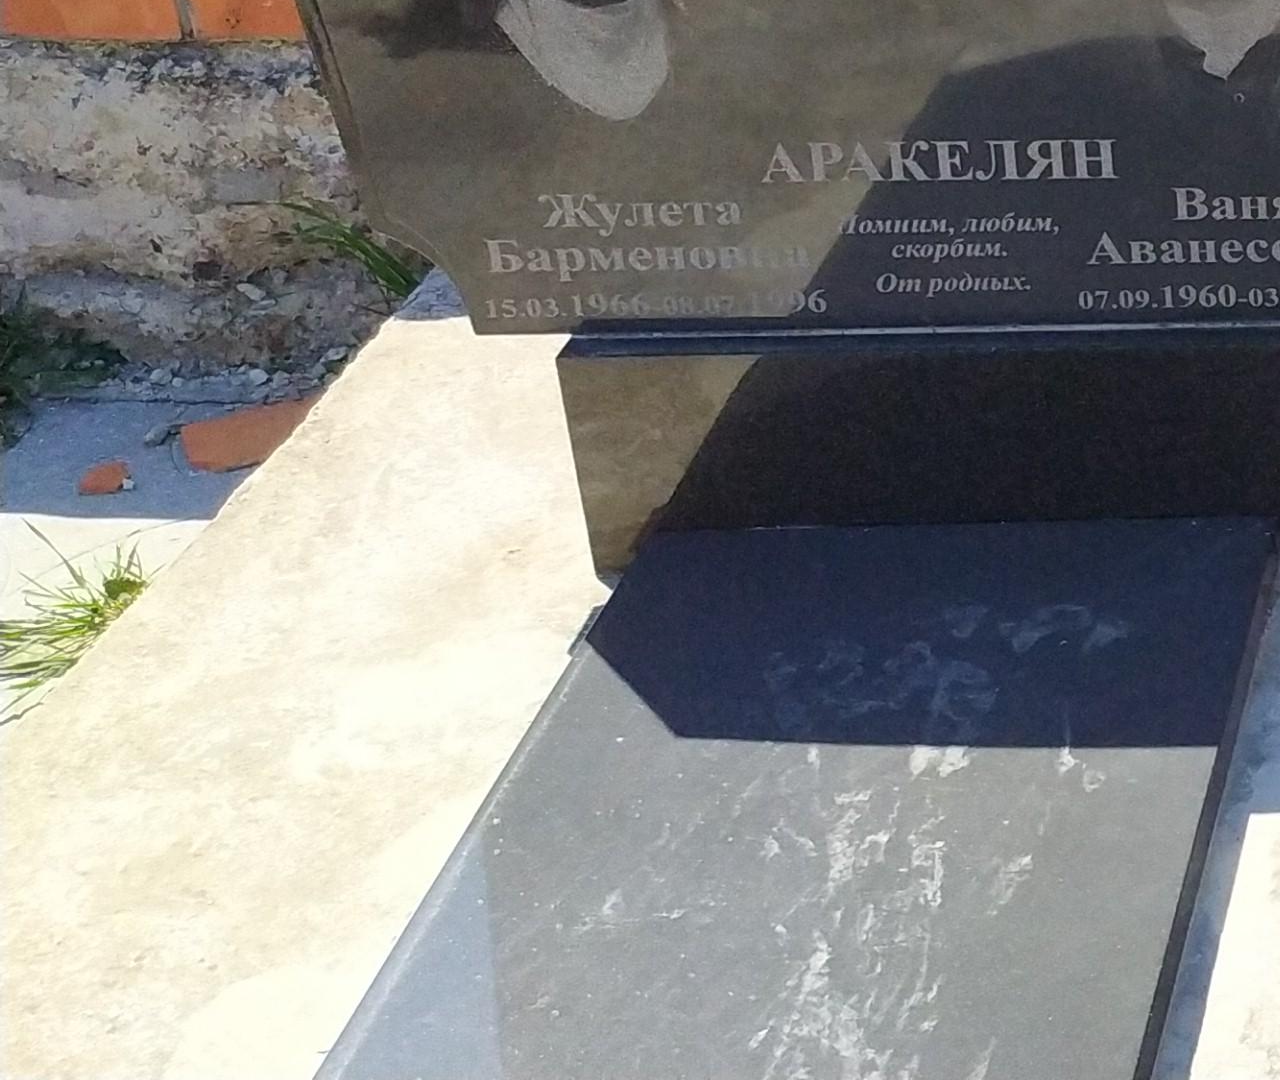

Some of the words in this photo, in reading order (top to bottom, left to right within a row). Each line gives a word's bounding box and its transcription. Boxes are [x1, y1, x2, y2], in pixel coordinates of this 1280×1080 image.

[761, 139, 1119, 182] АРАКЕЛЯН
[538, 193, 743, 236] Жулета
[961, 212, 1061, 234] любим,
[891, 238, 1008, 263] скорбим.
[875, 272, 921, 294] От
[926, 271, 1032, 298] родных.
